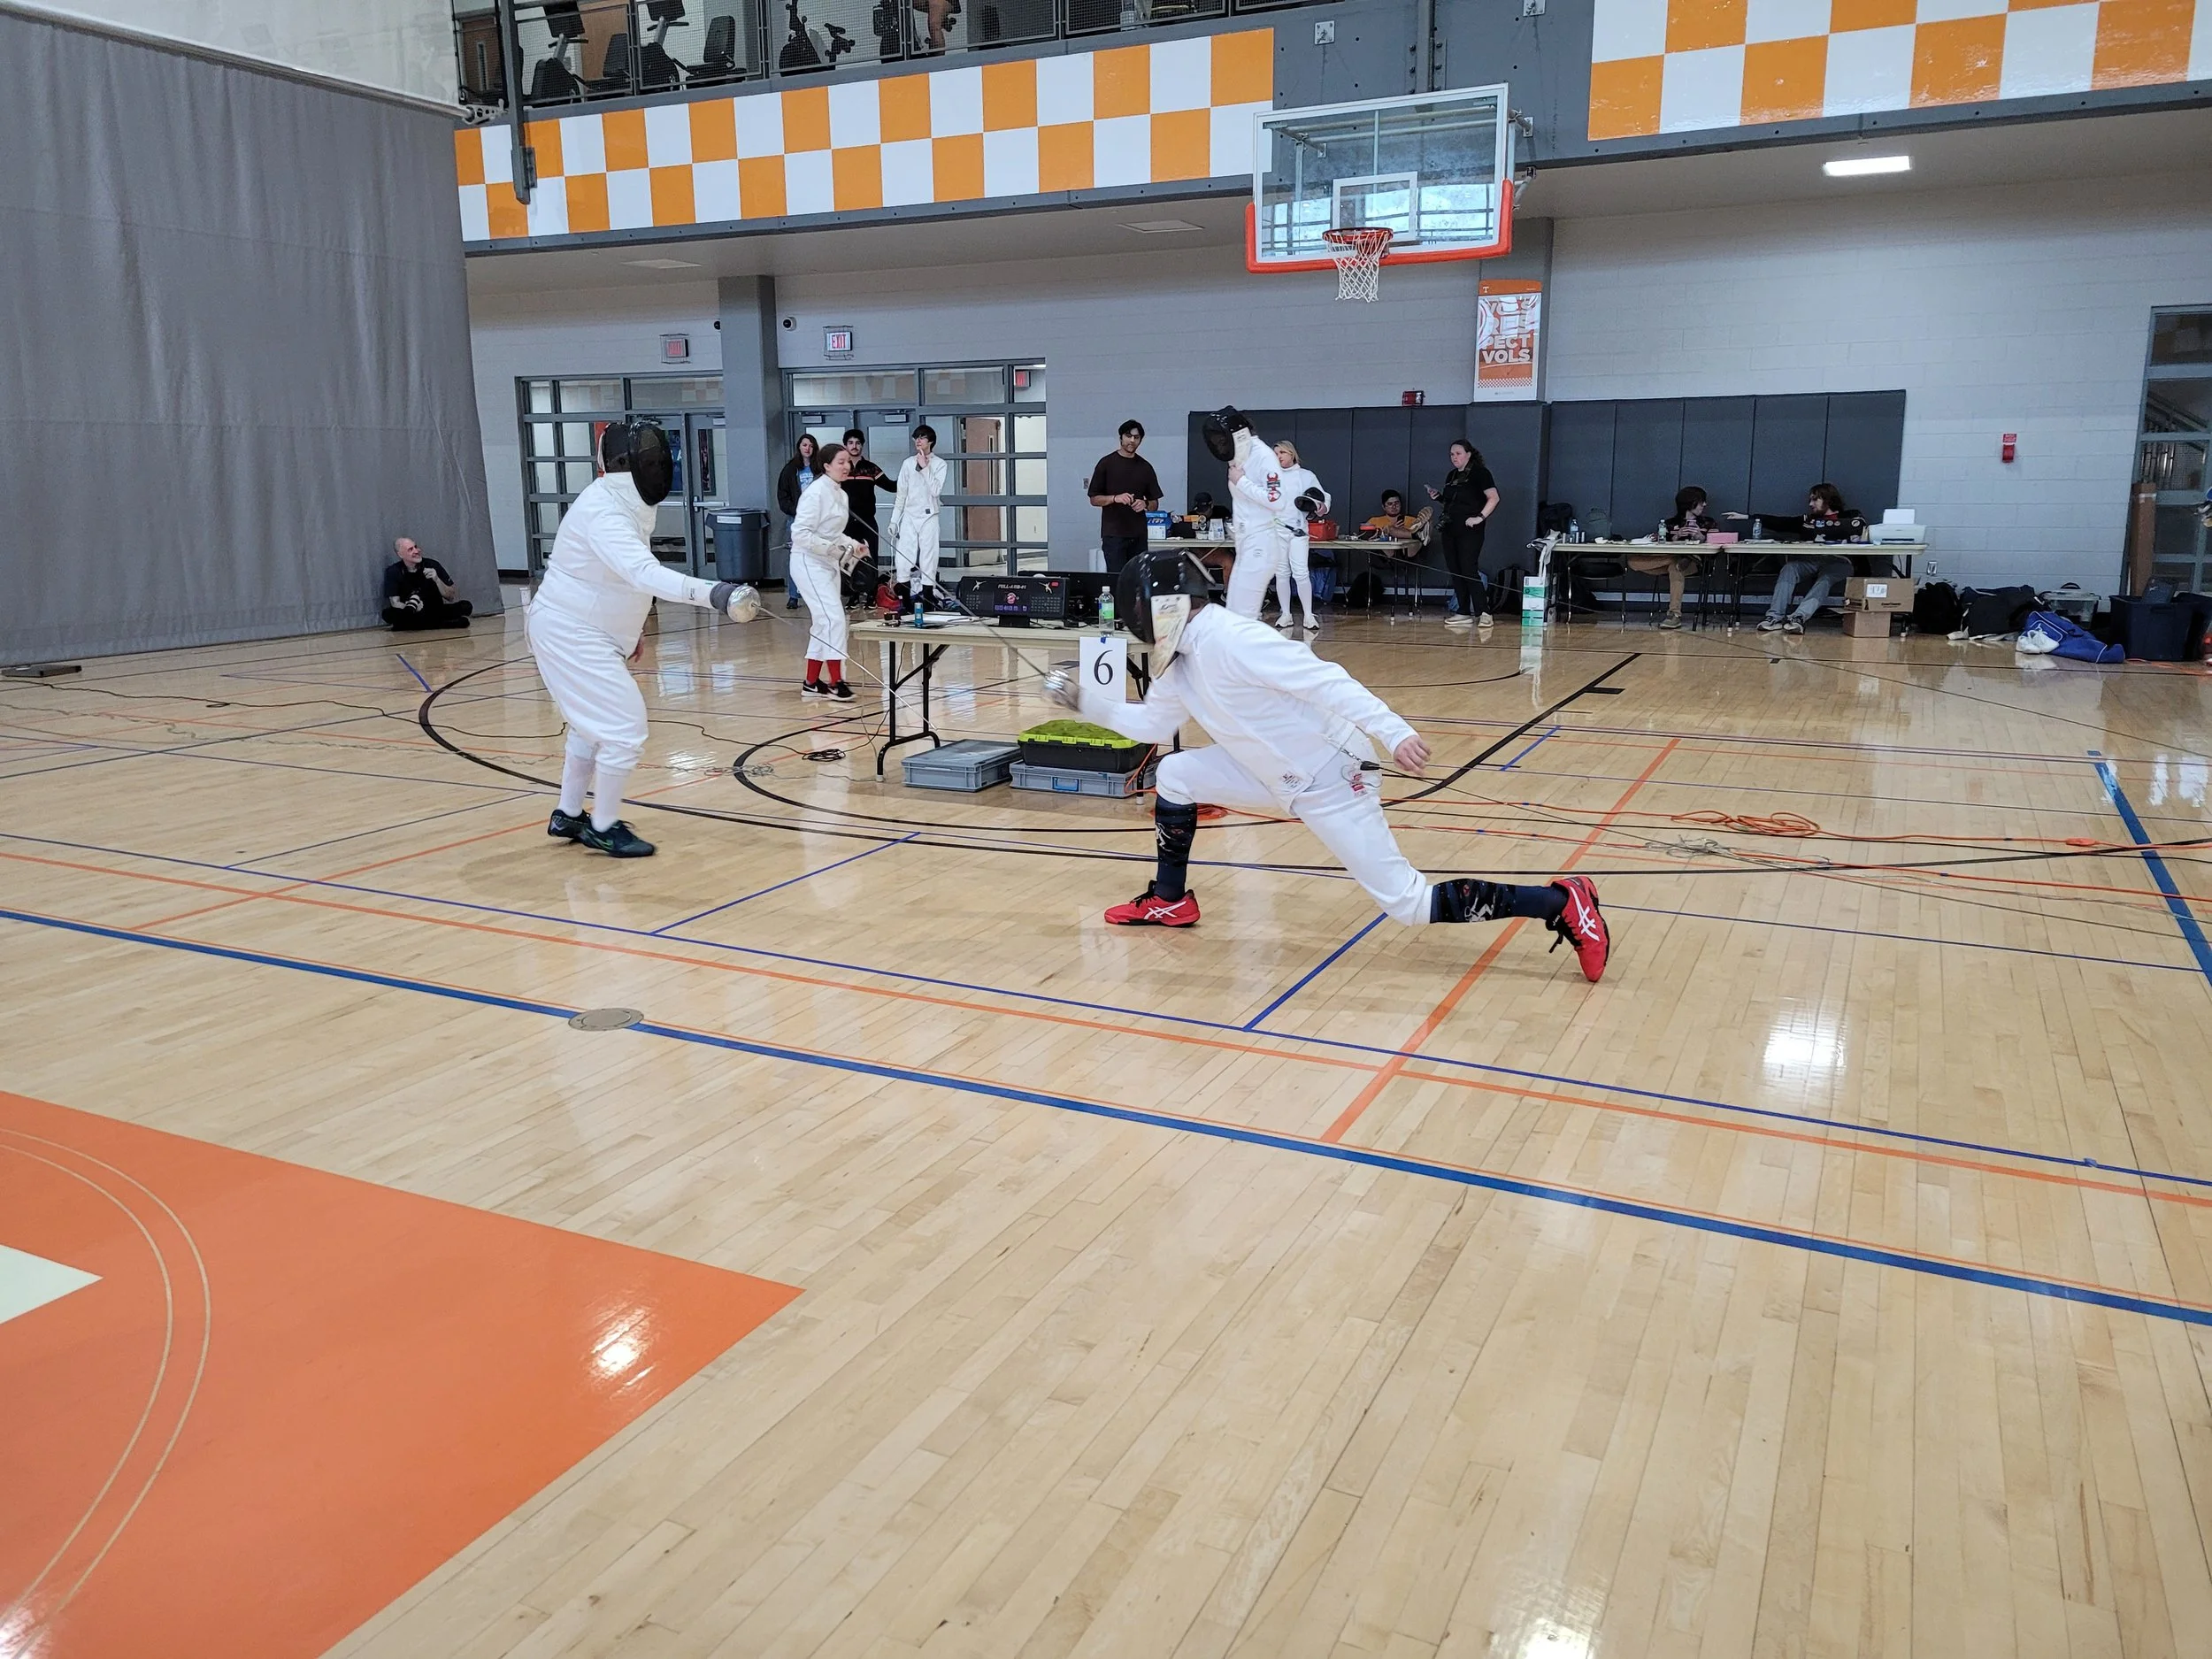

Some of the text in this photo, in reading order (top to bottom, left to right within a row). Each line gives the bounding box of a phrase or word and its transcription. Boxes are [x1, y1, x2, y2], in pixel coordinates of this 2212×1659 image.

[832, 334, 847, 349] EXIT
[1482, 334, 1531, 349] PECT
[1482, 348, 1531, 364] VOLS
[1094, 649, 1114, 686] 6
